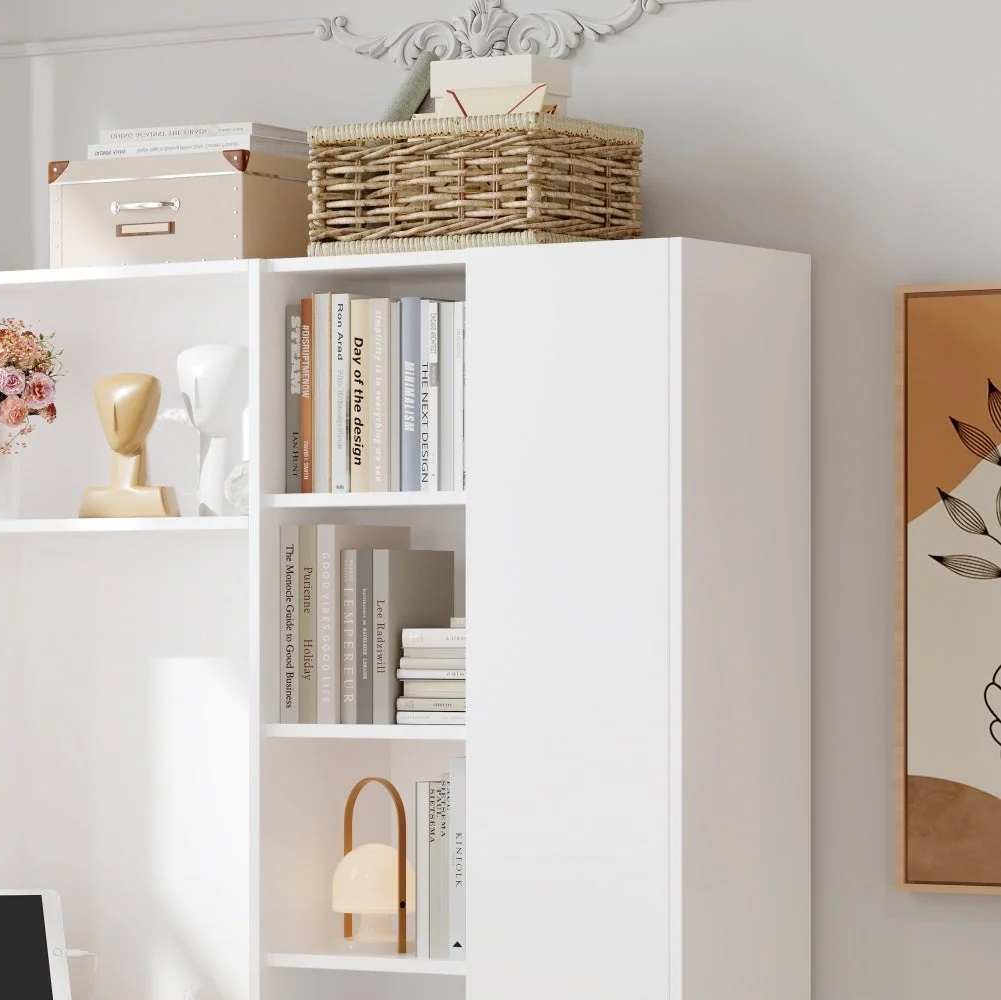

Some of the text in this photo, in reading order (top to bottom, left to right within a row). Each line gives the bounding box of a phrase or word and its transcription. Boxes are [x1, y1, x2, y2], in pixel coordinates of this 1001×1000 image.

[302, 324, 310, 398] #DISRUPTMENOW
[403, 361, 414, 432] MINIMALISM
[352, 337, 364, 466] Day of the design
[286, 544, 294, 709] The Monocle Guide to Good Business
[303, 567, 313, 681] Purienne Holiday
[343, 588, 354, 703] LEMPEREUR
[376, 599, 386, 674] Lee Radziwill
[322, 676, 331, 703] LIFE
[455, 832, 463, 887] KINFOLK
